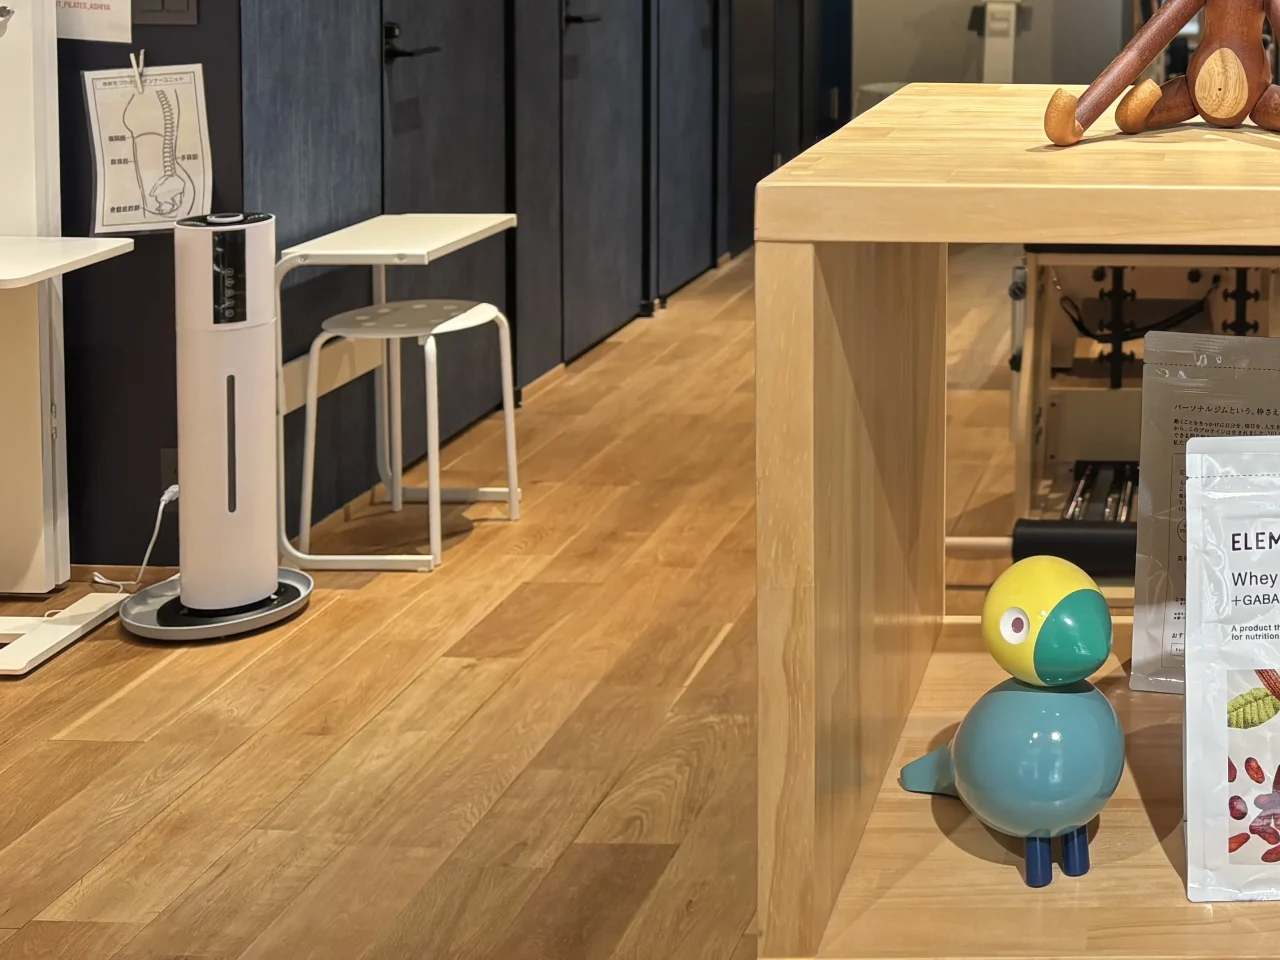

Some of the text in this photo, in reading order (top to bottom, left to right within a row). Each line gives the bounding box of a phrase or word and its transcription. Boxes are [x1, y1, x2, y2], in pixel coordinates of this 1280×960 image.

[56, 1, 110, 11] T_PILATES_ASHIYA
[1231, 571, 1278, 588] Whey
[1239, 624, 1272, 633] product
